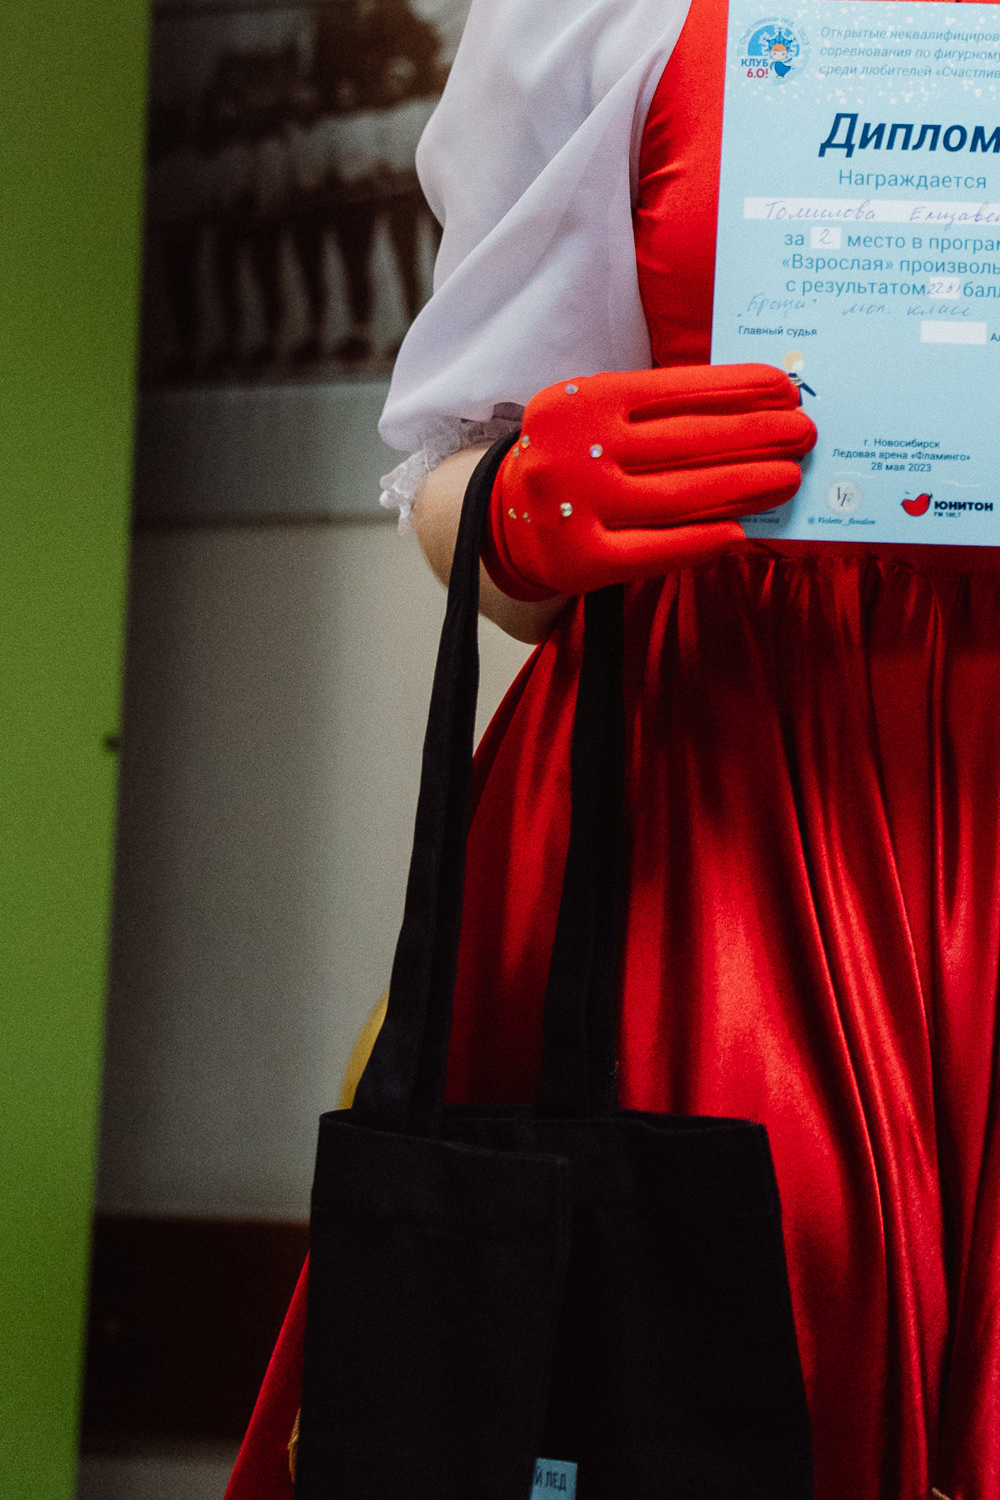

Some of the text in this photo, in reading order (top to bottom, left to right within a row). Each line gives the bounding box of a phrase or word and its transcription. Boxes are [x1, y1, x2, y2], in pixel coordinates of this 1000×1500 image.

[820, 27, 886, 40] Открытые
[820, 47, 912, 58] соревнования
[916, 50, 930, 58] по
[741, 58, 768, 67] КЛУБ
[747, 68, 768, 78] 6.0!
[819, 67, 857, 78] среди
[860, 66, 932, 77] любителей
[839, 169, 986, 190] Награждается
[784, 234, 805, 246] за
[818, 227, 833, 246] 2
[847, 236, 904, 250] место
[912, 238, 922, 250] в
[782, 255, 893, 275] «Взрослая»
[786, 281, 796, 292] с
[802, 279, 925, 298] результатом
[738, 325, 817, 338] Главный судья
[874, 438, 940, 449] Новосибирск
[833, 448, 970, 463] Ледовая арена «Фламинго»
[871, 462, 883, 471] 28
[908, 463, 932, 472] 2023
[934, 501, 993, 511] ЮНИТОН
